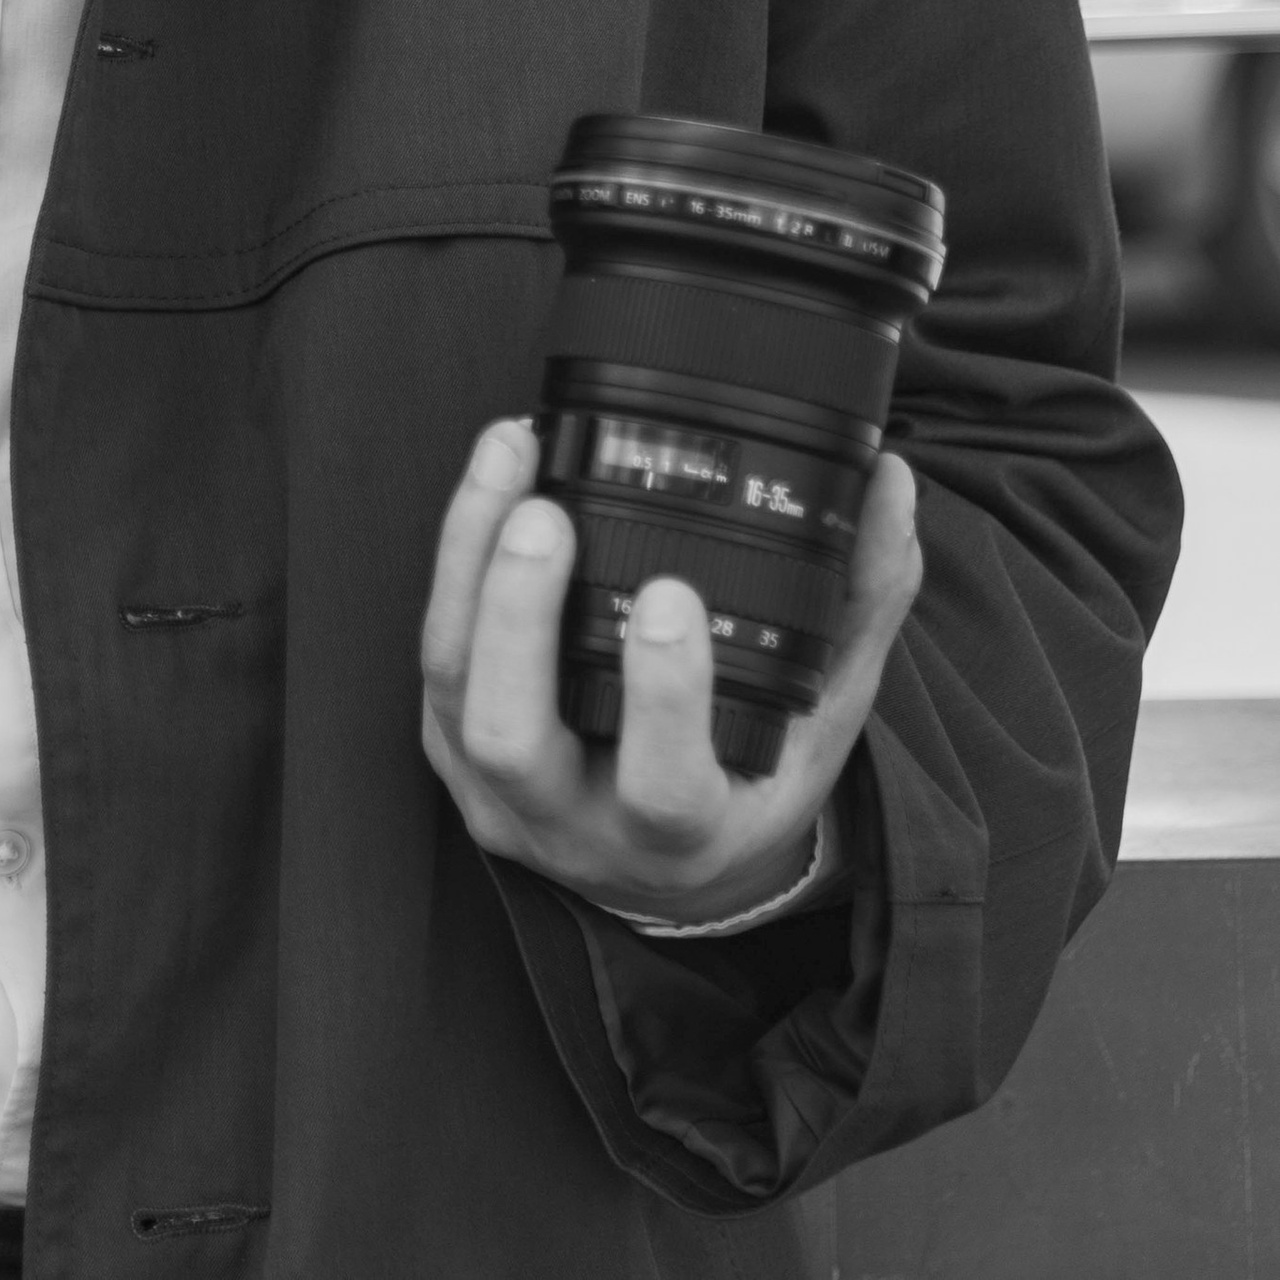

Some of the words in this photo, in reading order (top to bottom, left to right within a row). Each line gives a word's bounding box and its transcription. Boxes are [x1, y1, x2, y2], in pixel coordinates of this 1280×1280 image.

[690, 199, 762, 227] 16-35mm
[747, 479, 804, 519] 16-35mm
[613, 597, 632, 615] 16
[711, 619, 734, 637] 28
[759, 630, 781, 650] 35
